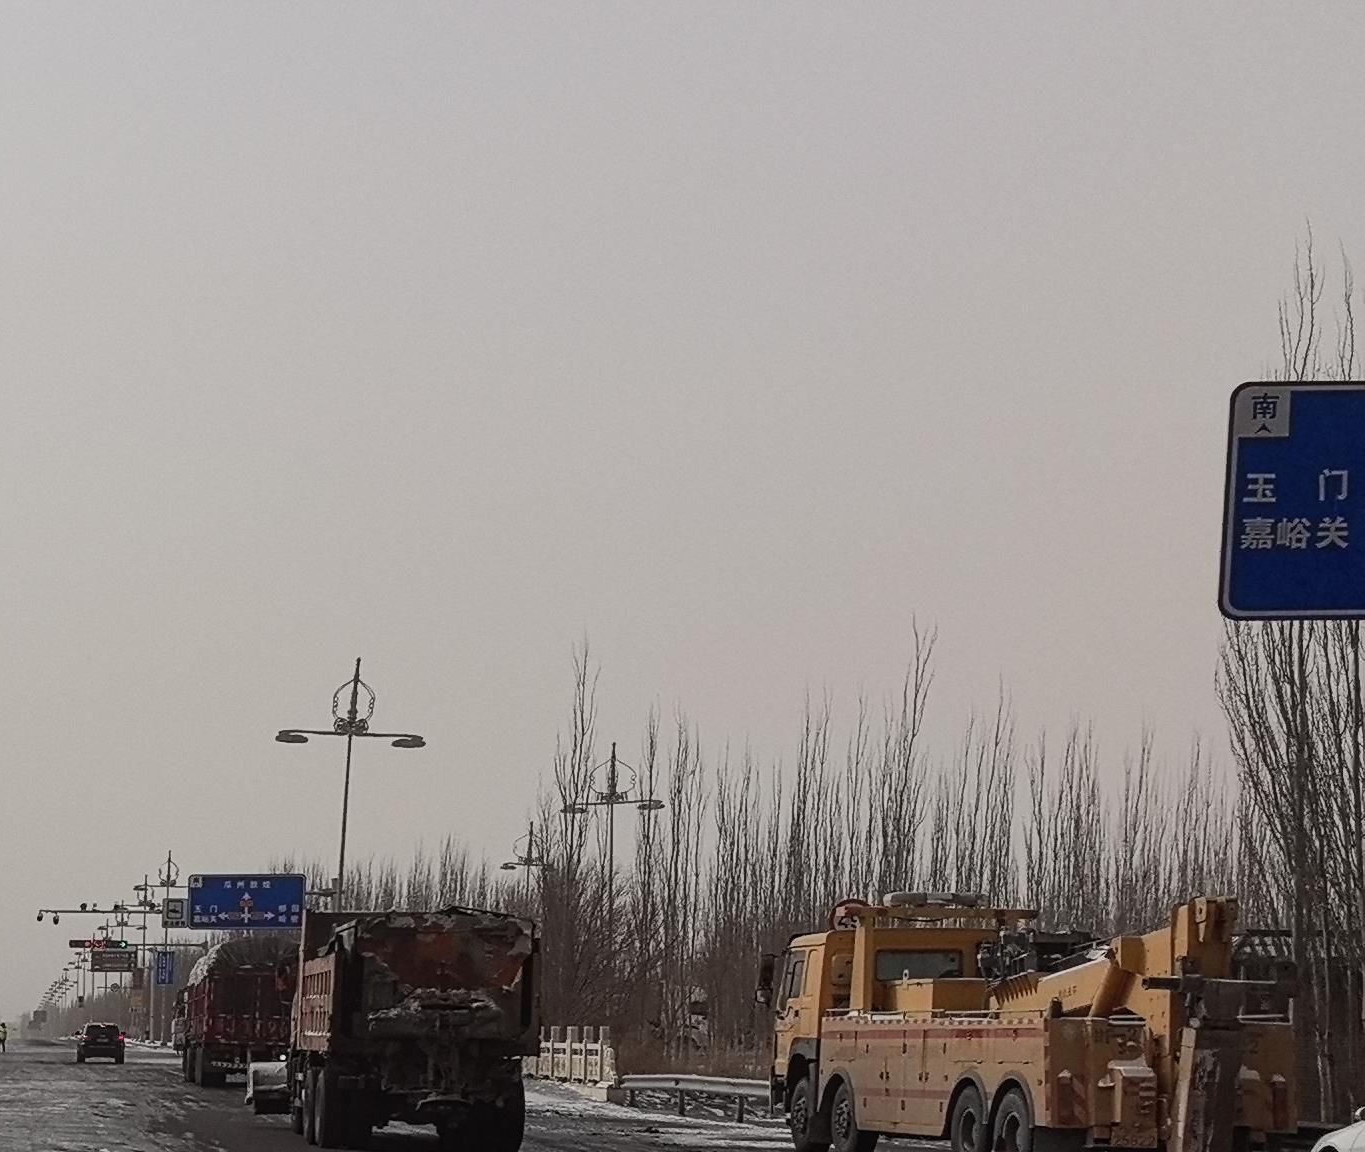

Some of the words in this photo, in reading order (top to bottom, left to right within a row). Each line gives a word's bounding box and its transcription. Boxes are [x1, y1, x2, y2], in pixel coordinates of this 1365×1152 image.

[1251, 392, 1280, 421] 南
[1243, 469, 1349, 503] 玉门
[1240, 516, 1349, 550] 嘉峪关
